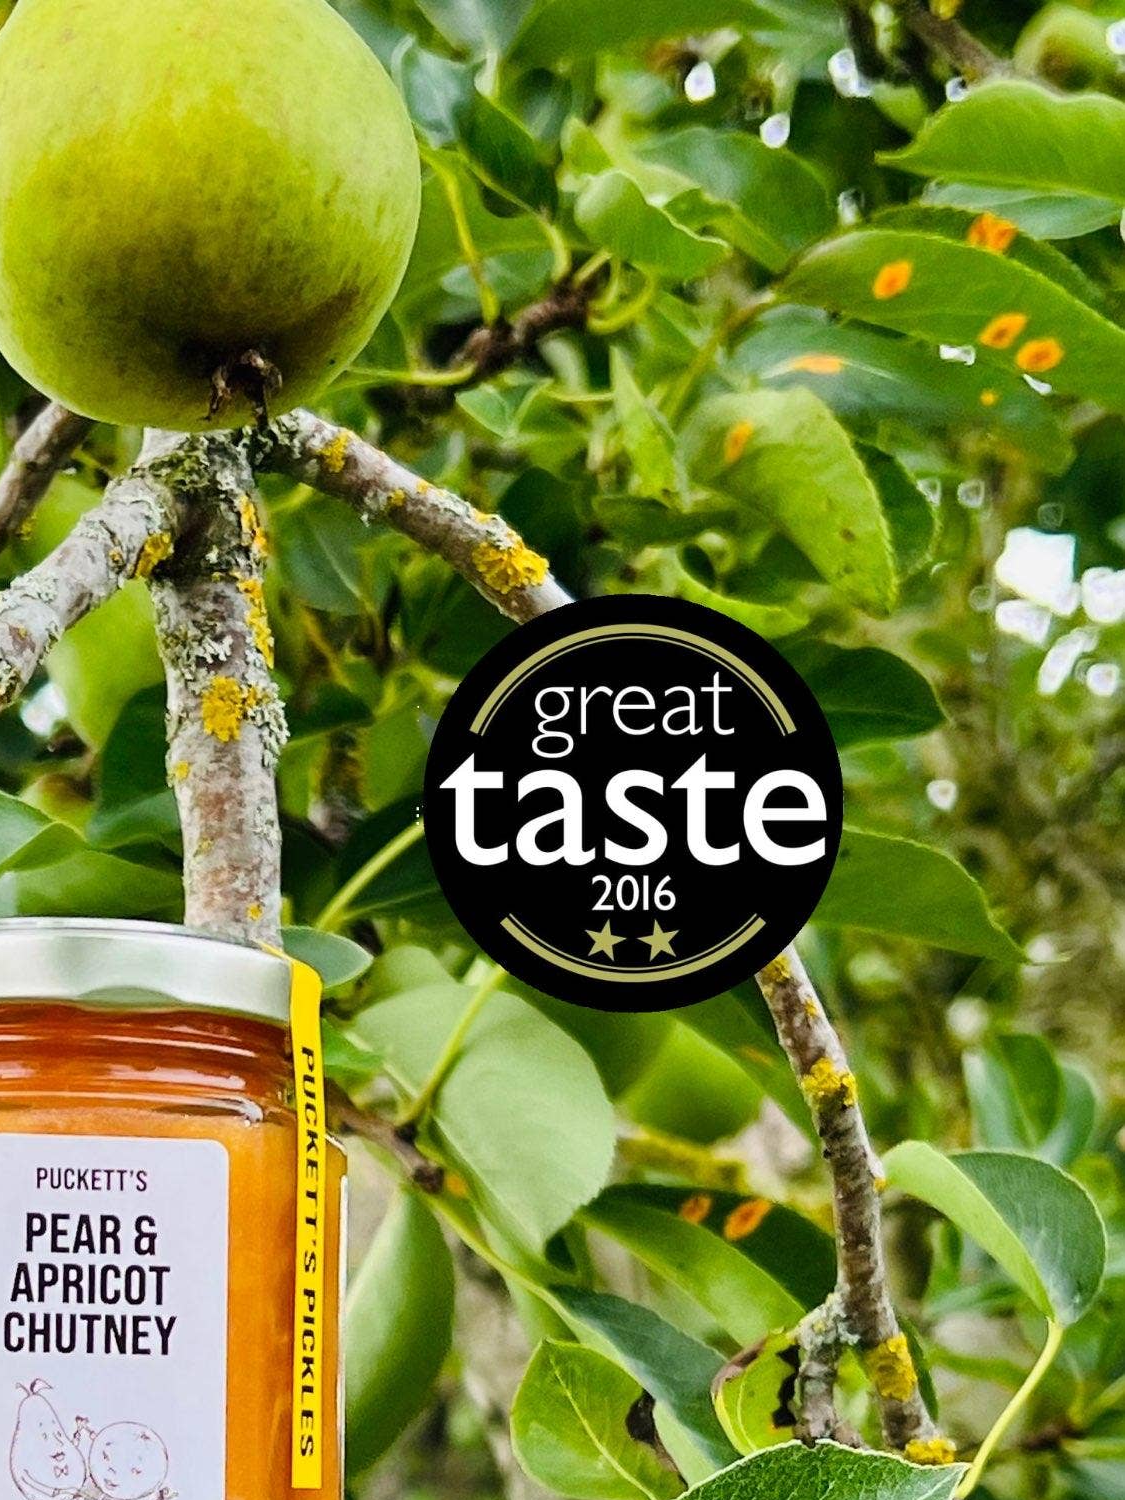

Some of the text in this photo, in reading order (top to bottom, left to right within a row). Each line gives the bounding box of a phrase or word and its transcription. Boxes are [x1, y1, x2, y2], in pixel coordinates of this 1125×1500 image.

[36, 1167, 149, 1192] PUCKETT'S
[25, 1212, 158, 1256] PEAR &
[300, 1046, 319, 1458] PUCKETT'S PICKLES
[10, 1262, 171, 1306] APRICOT
[3, 1311, 178, 1356] CHUTNEY
